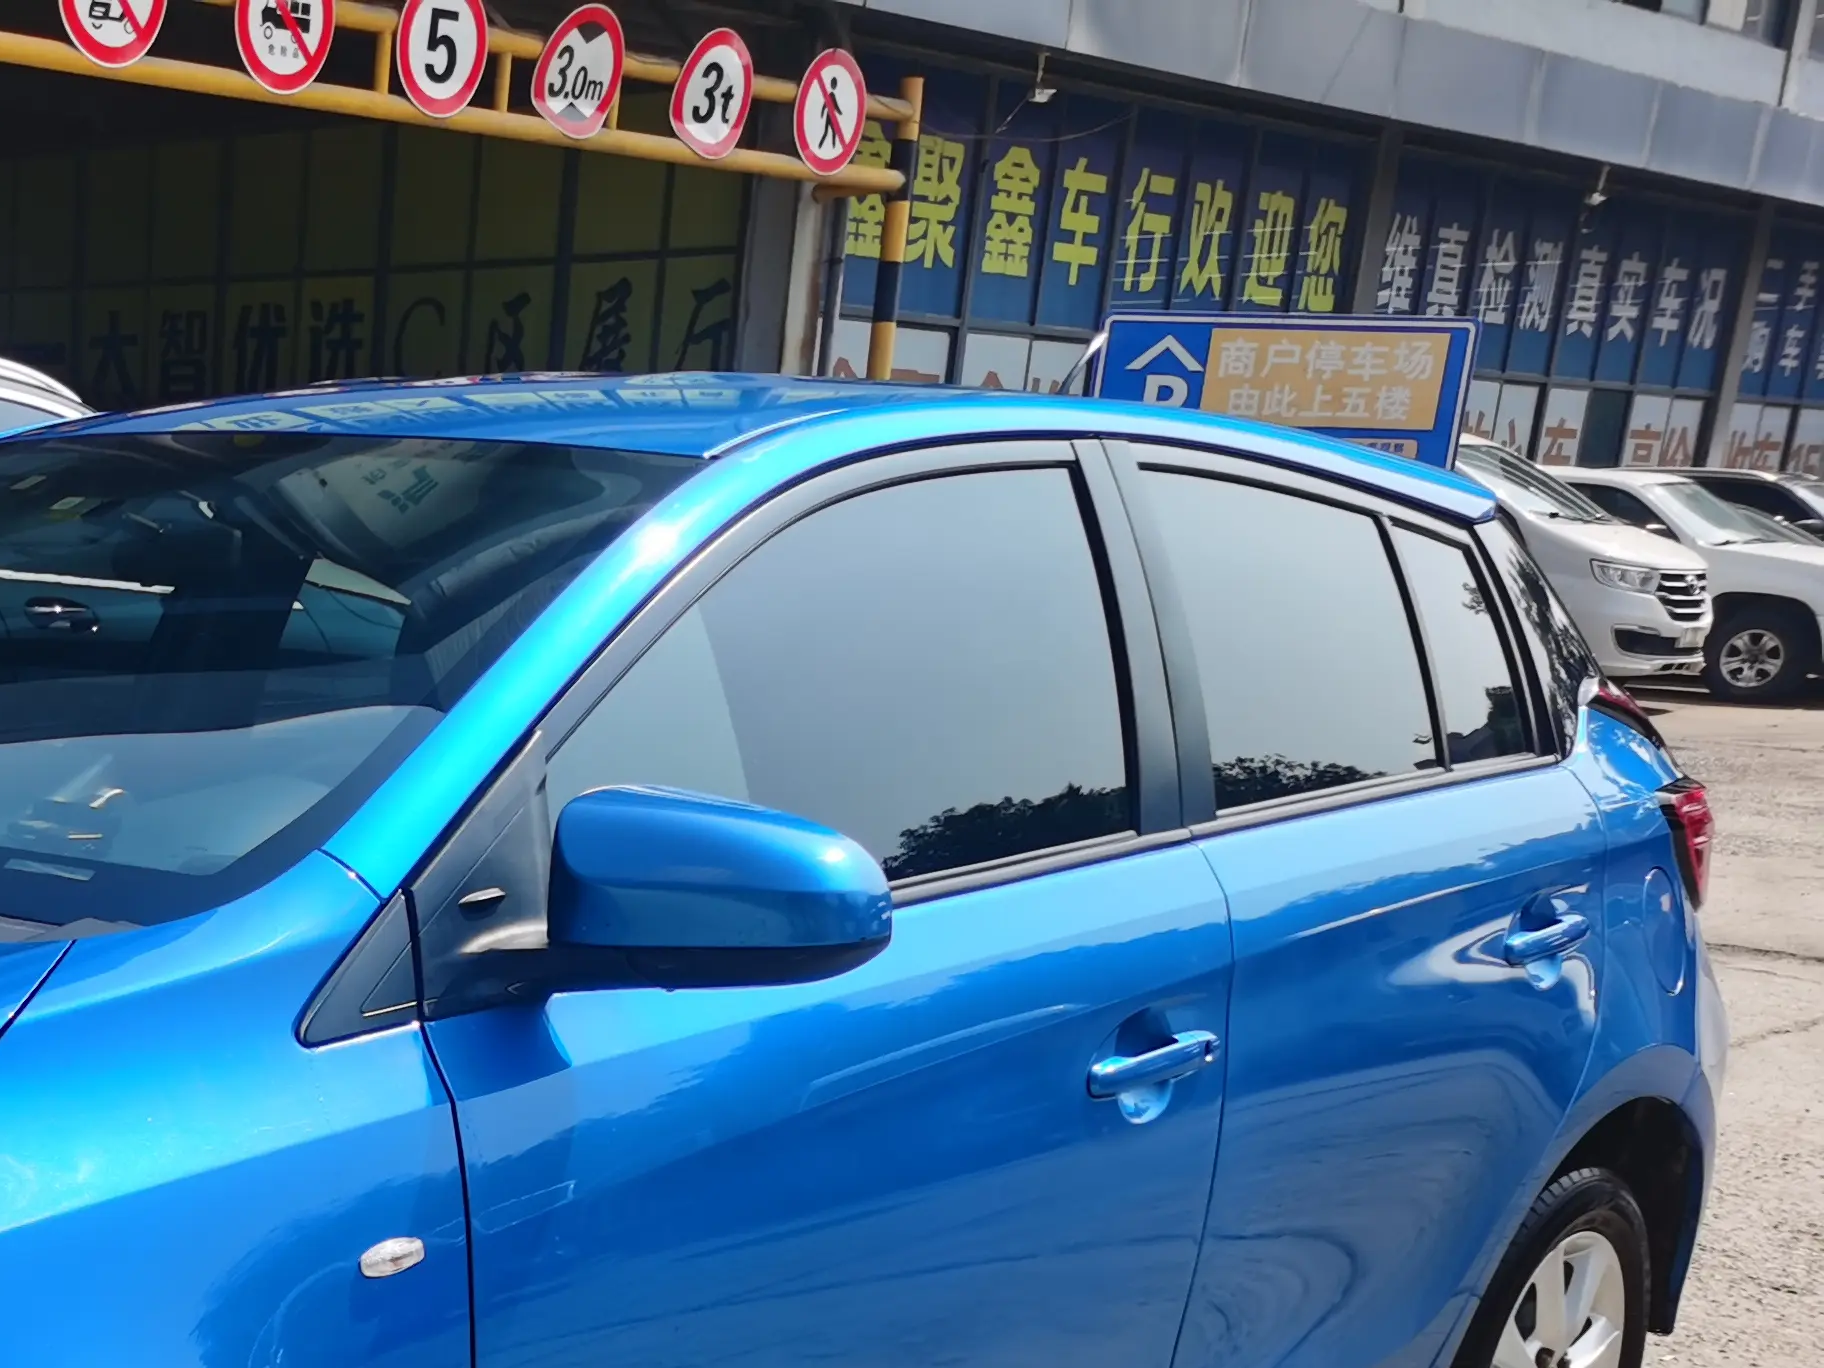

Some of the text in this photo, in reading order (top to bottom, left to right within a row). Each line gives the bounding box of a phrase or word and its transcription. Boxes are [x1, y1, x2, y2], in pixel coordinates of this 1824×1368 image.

[424, 7, 459, 84] 5
[547, 45, 604, 101] 3.0m
[692, 62, 734, 124] 3t
[1218, 338, 1435, 381] 商户停车场
[1227, 384, 1413, 422] 由此上五楼
